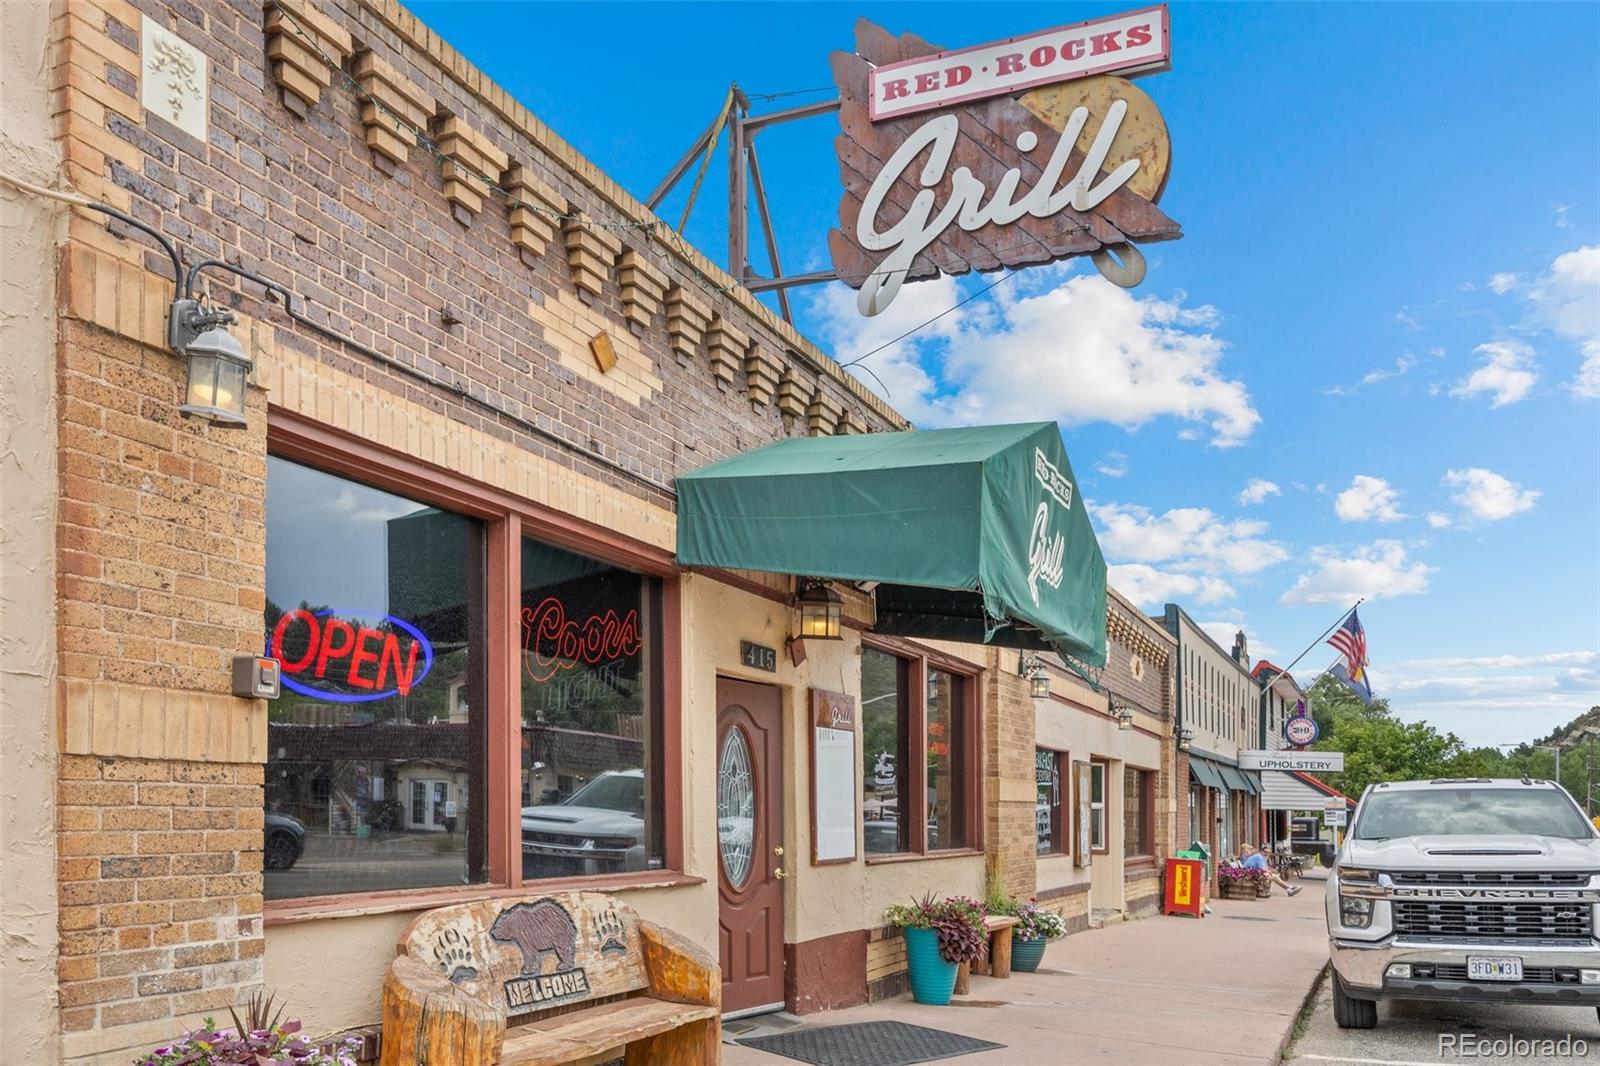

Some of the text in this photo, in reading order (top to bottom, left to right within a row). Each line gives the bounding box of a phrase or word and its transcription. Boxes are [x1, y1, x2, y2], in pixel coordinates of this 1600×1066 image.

[882, 23, 1153, 102] RED ROCKS
[856, 100, 1141, 317] Grill
[271, 608, 421, 697] OPEN
[521, 597, 643, 681] Coors
[745, 645, 774, 670] 415
[1259, 760, 1332, 770] UPHOLSTERY
[1393, 888, 1590, 899] CHEVROLET
